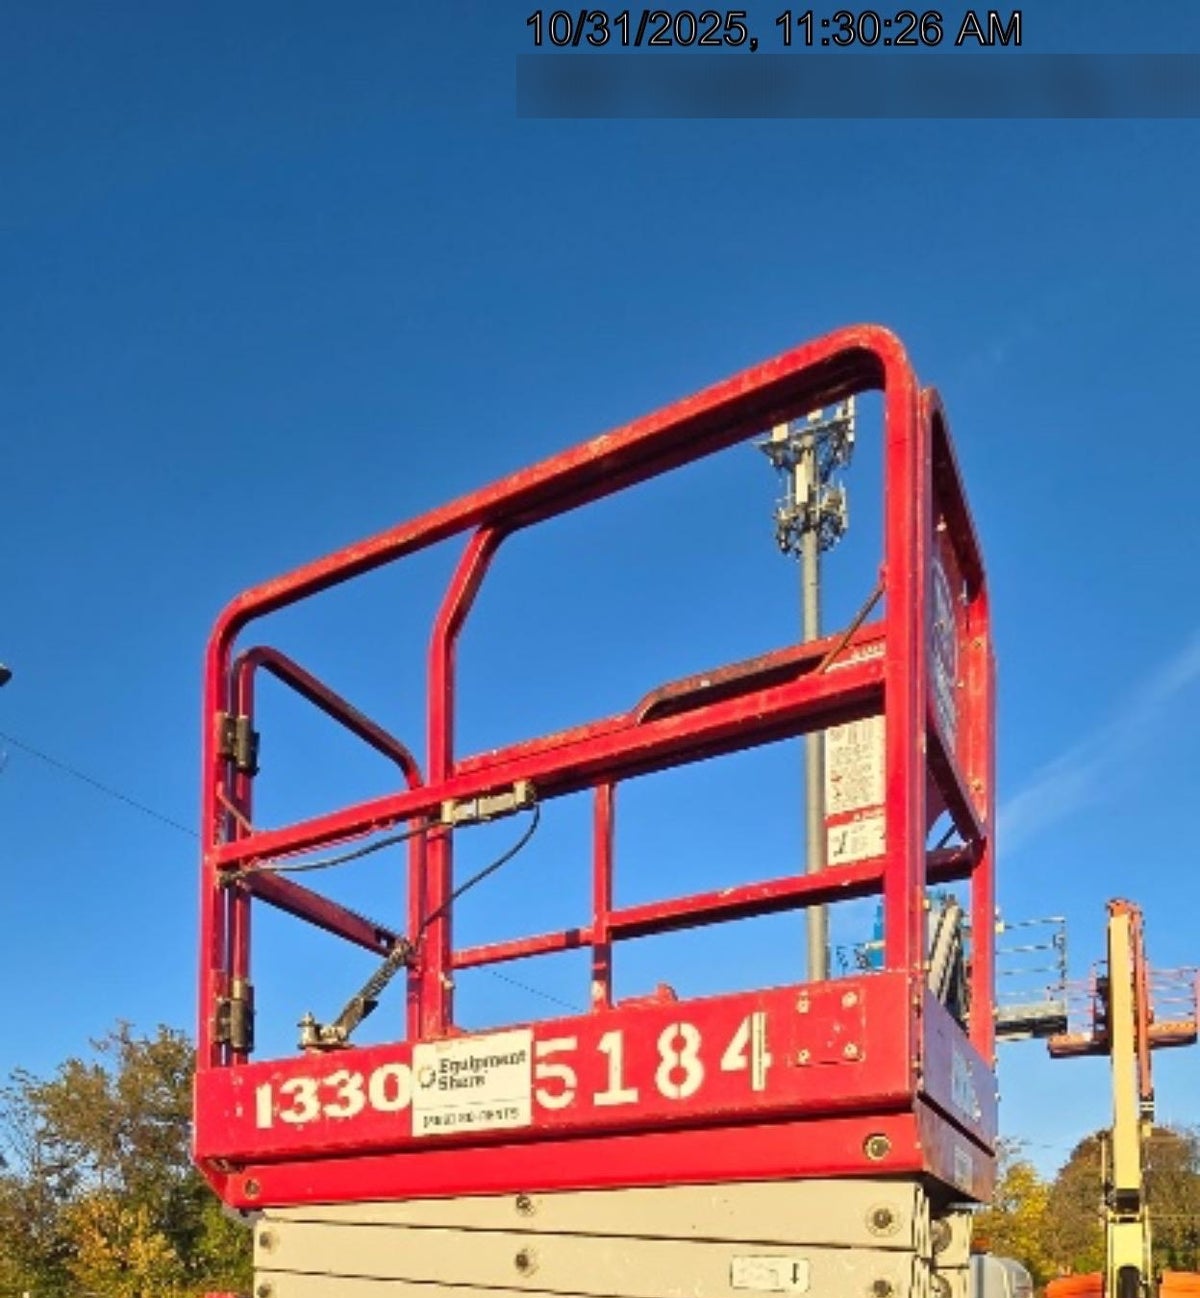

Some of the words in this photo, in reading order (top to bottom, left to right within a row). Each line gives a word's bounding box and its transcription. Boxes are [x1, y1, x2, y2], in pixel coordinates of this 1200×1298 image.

[439, 1050, 526, 1076] Equipment
[535, 1011, 772, 1109] 5184
[256, 1063, 412, 1129] 1330
